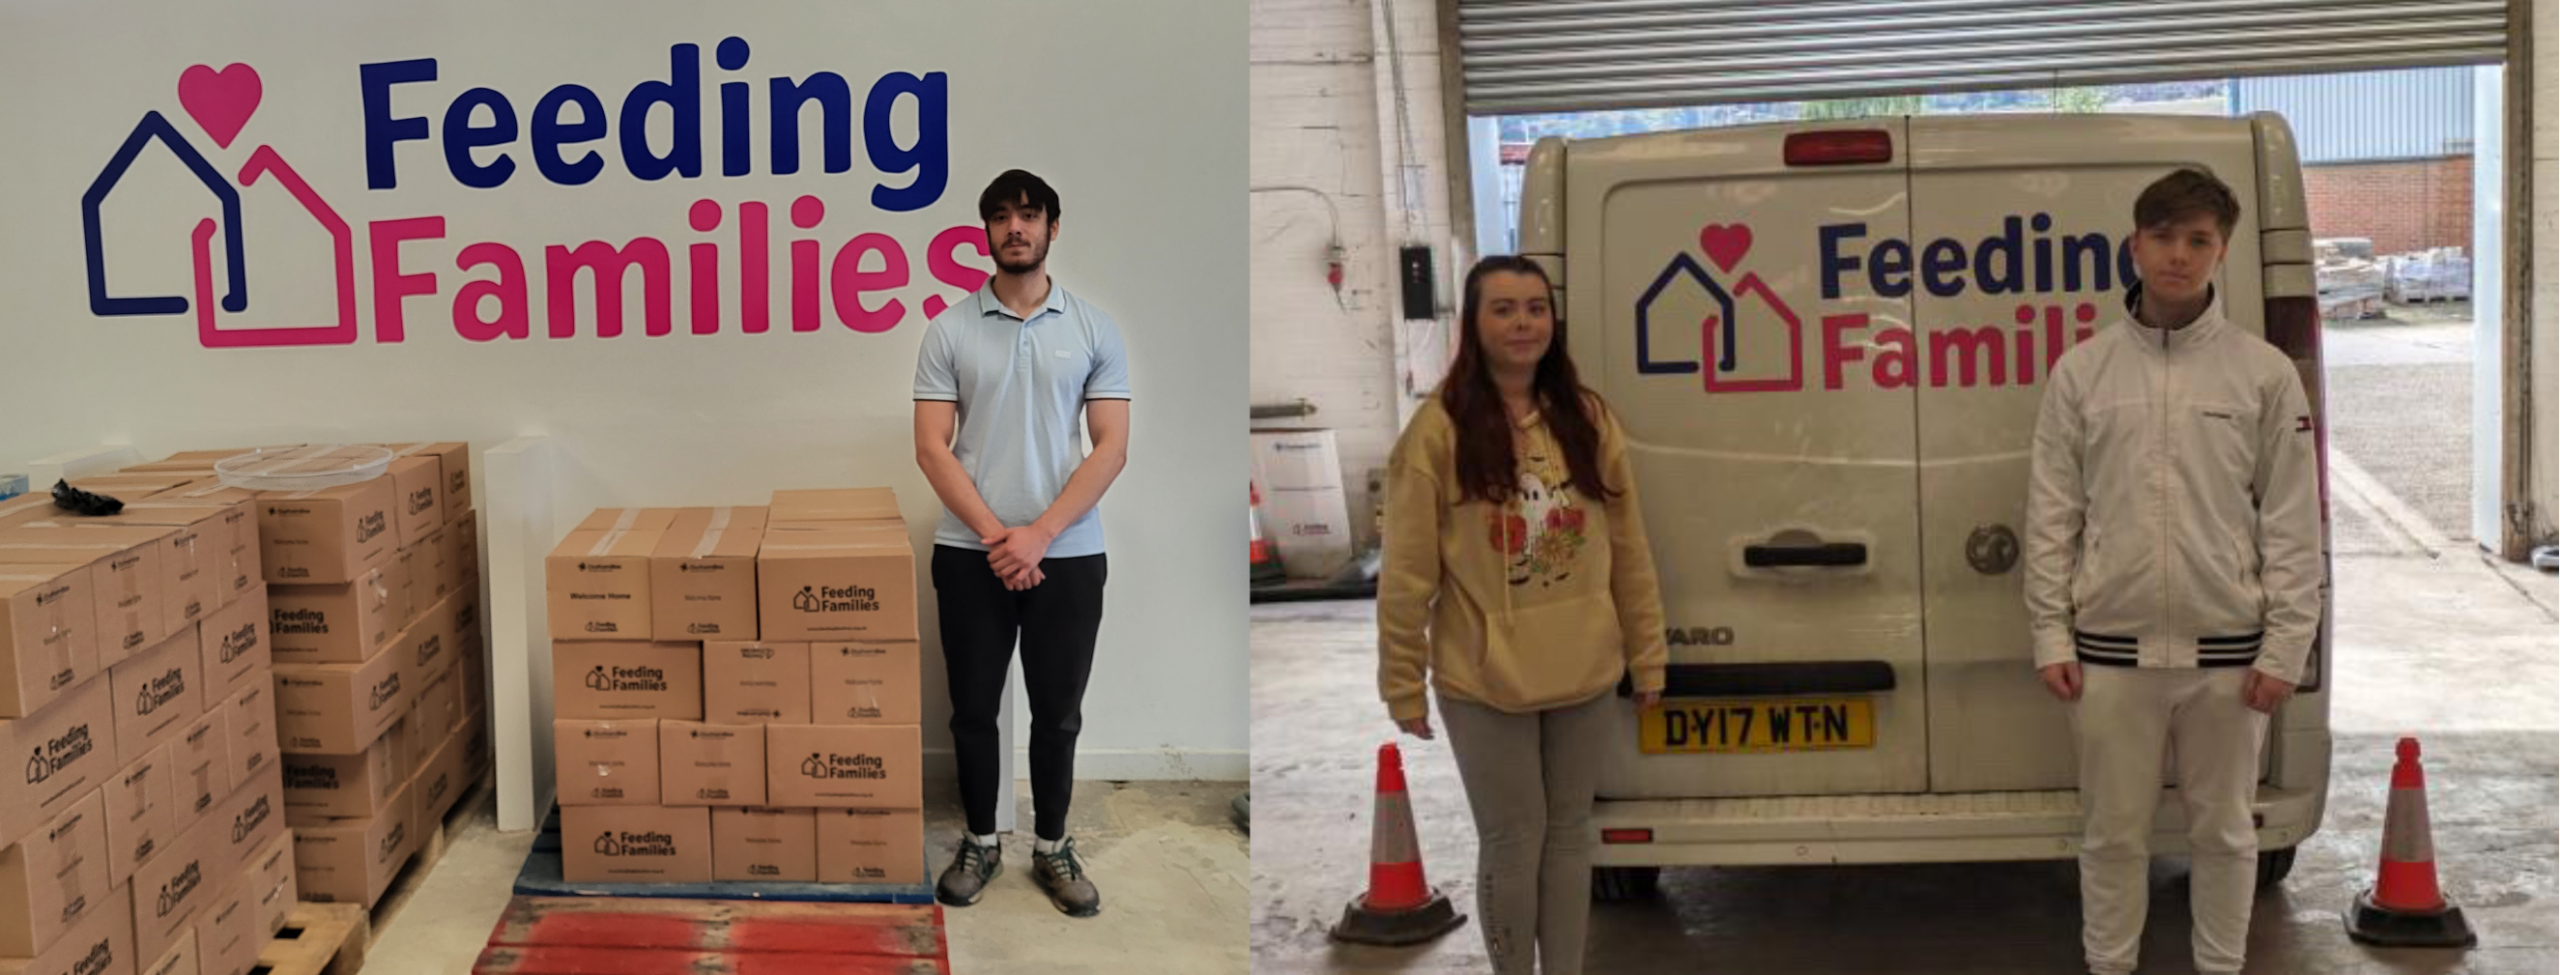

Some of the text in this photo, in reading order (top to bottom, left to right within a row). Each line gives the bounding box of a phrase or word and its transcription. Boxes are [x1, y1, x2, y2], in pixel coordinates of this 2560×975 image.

[361, 37, 948, 212] Feeding
[1819, 212, 2137, 299] Feedin
[368, 194, 991, 344] Families
[821, 585, 875, 600] Feeding
[822, 599, 879, 612] Families
[274, 609, 324, 624] Feeding
[275, 622, 329, 634] Families
[1666, 627, 1734, 646] ARO
[152, 667, 182, 693] Feeding
[612, 666, 663, 681] Feeding
[612, 679, 667, 691] Families
[1664, 703, 1848, 746] DY17 WTN
[48, 722, 88, 756] Feeding
[50, 738, 92, 775] Families
[829, 753, 882, 769] Feeding
[287, 765, 335, 779] Feeding
[830, 767, 886, 779] Families
[288, 778, 339, 789] Families
[621, 831, 672, 846] Feeding
[622, 844, 676, 856] Families
